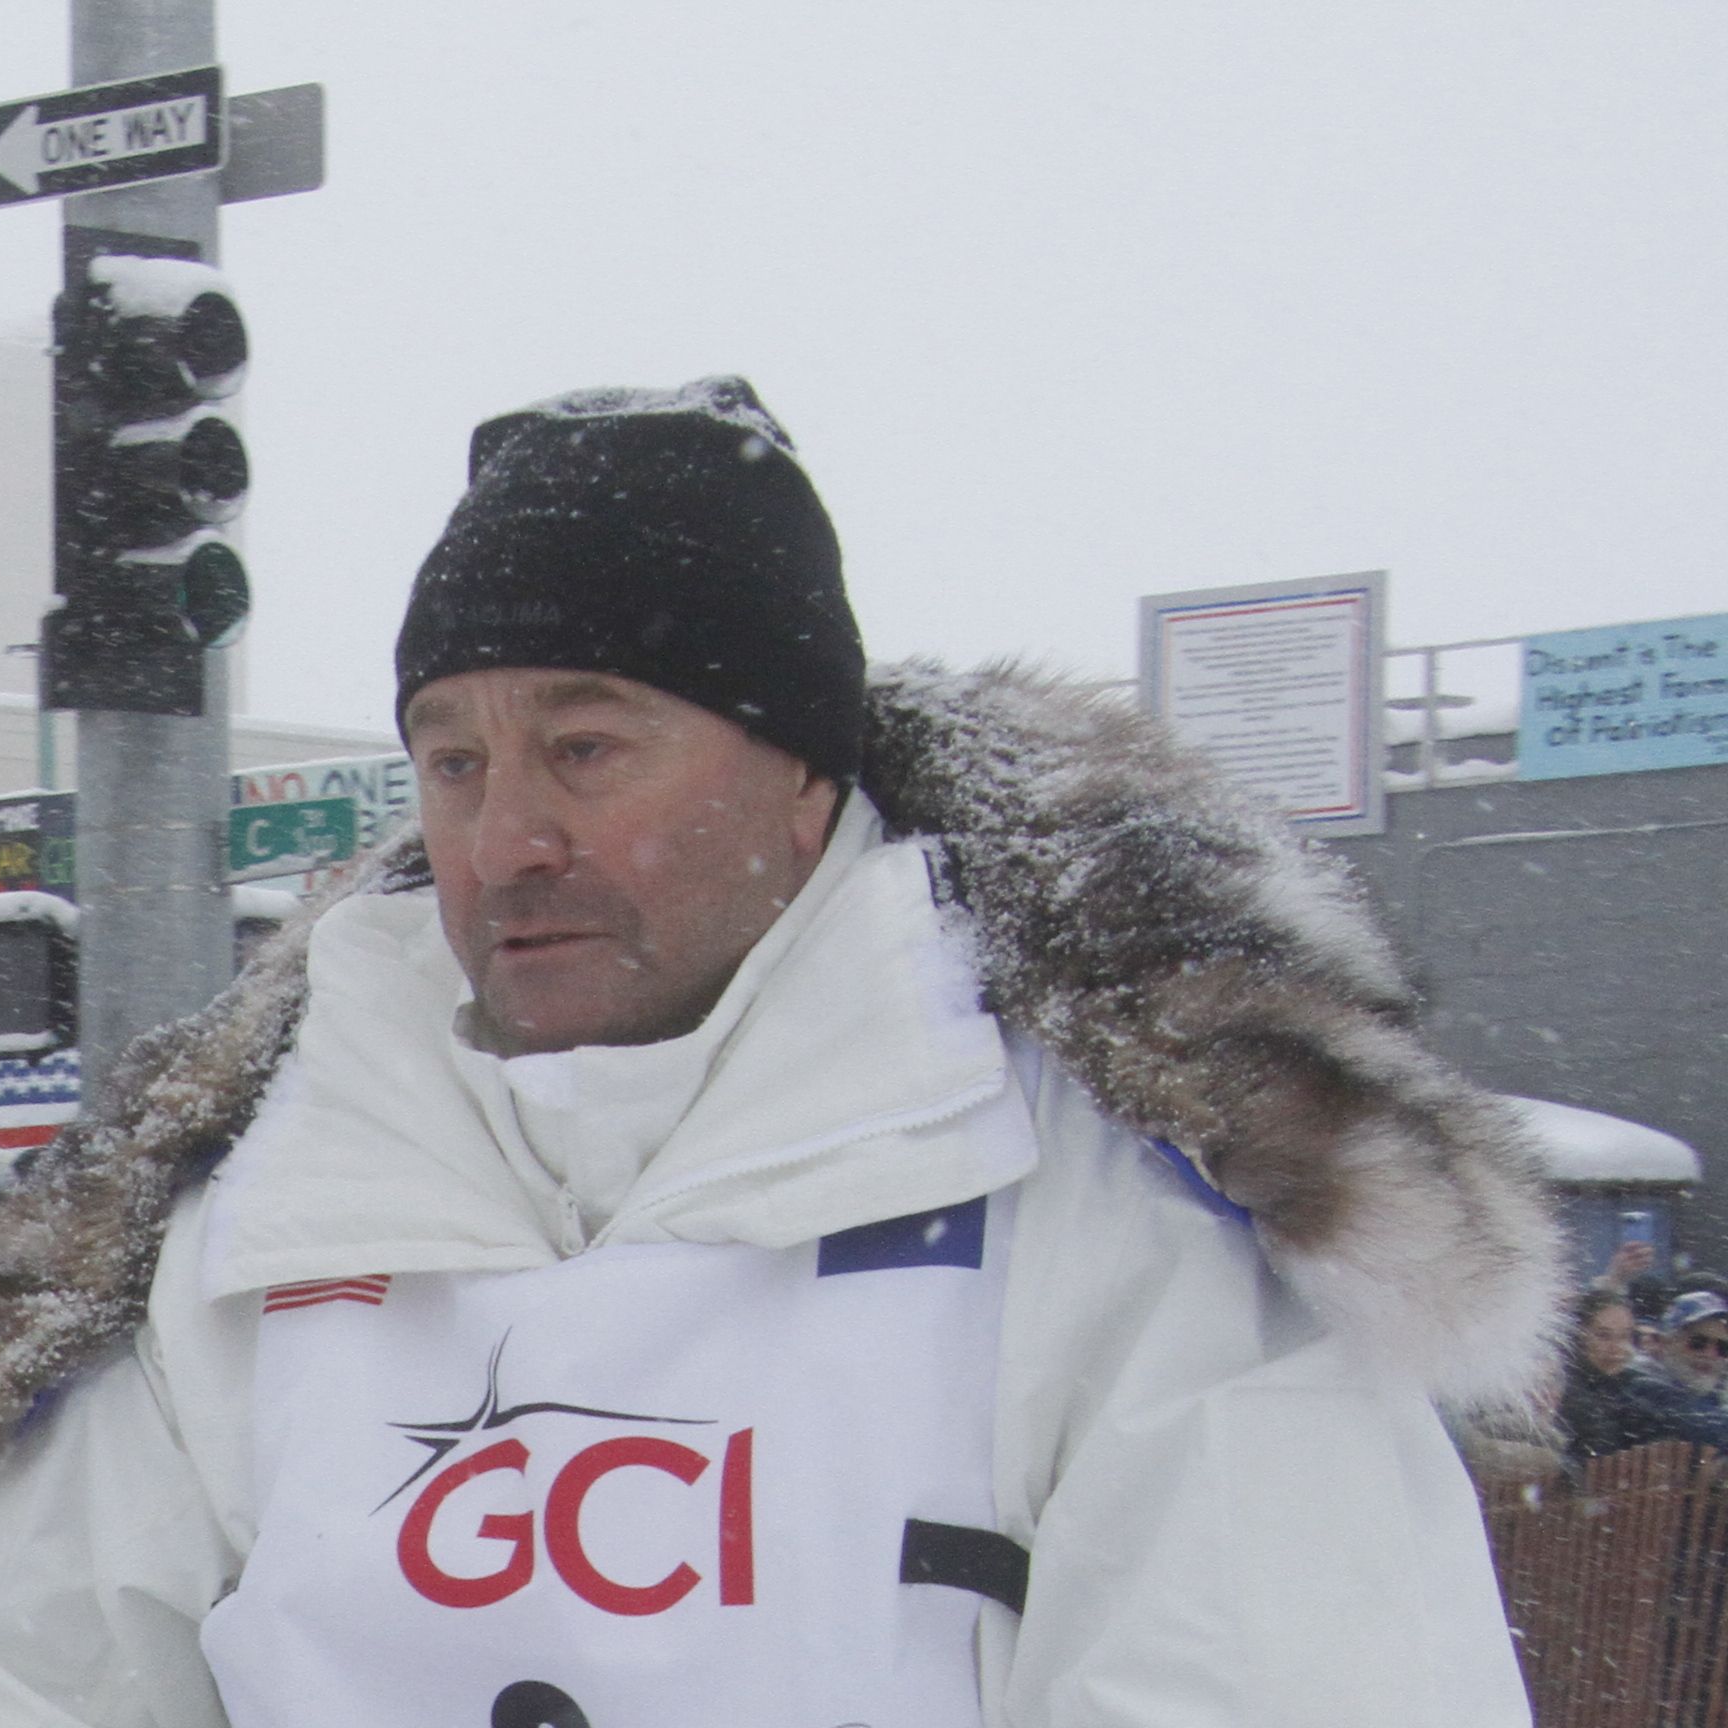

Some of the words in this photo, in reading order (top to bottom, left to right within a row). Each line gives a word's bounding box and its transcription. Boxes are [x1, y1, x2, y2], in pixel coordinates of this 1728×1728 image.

[44, 117, 112, 165] ONE
[123, 102, 196, 150] WAY
[319, 760, 409, 805] ONE
[246, 818, 273, 858] C
[396, 1426, 756, 1617] GCI
